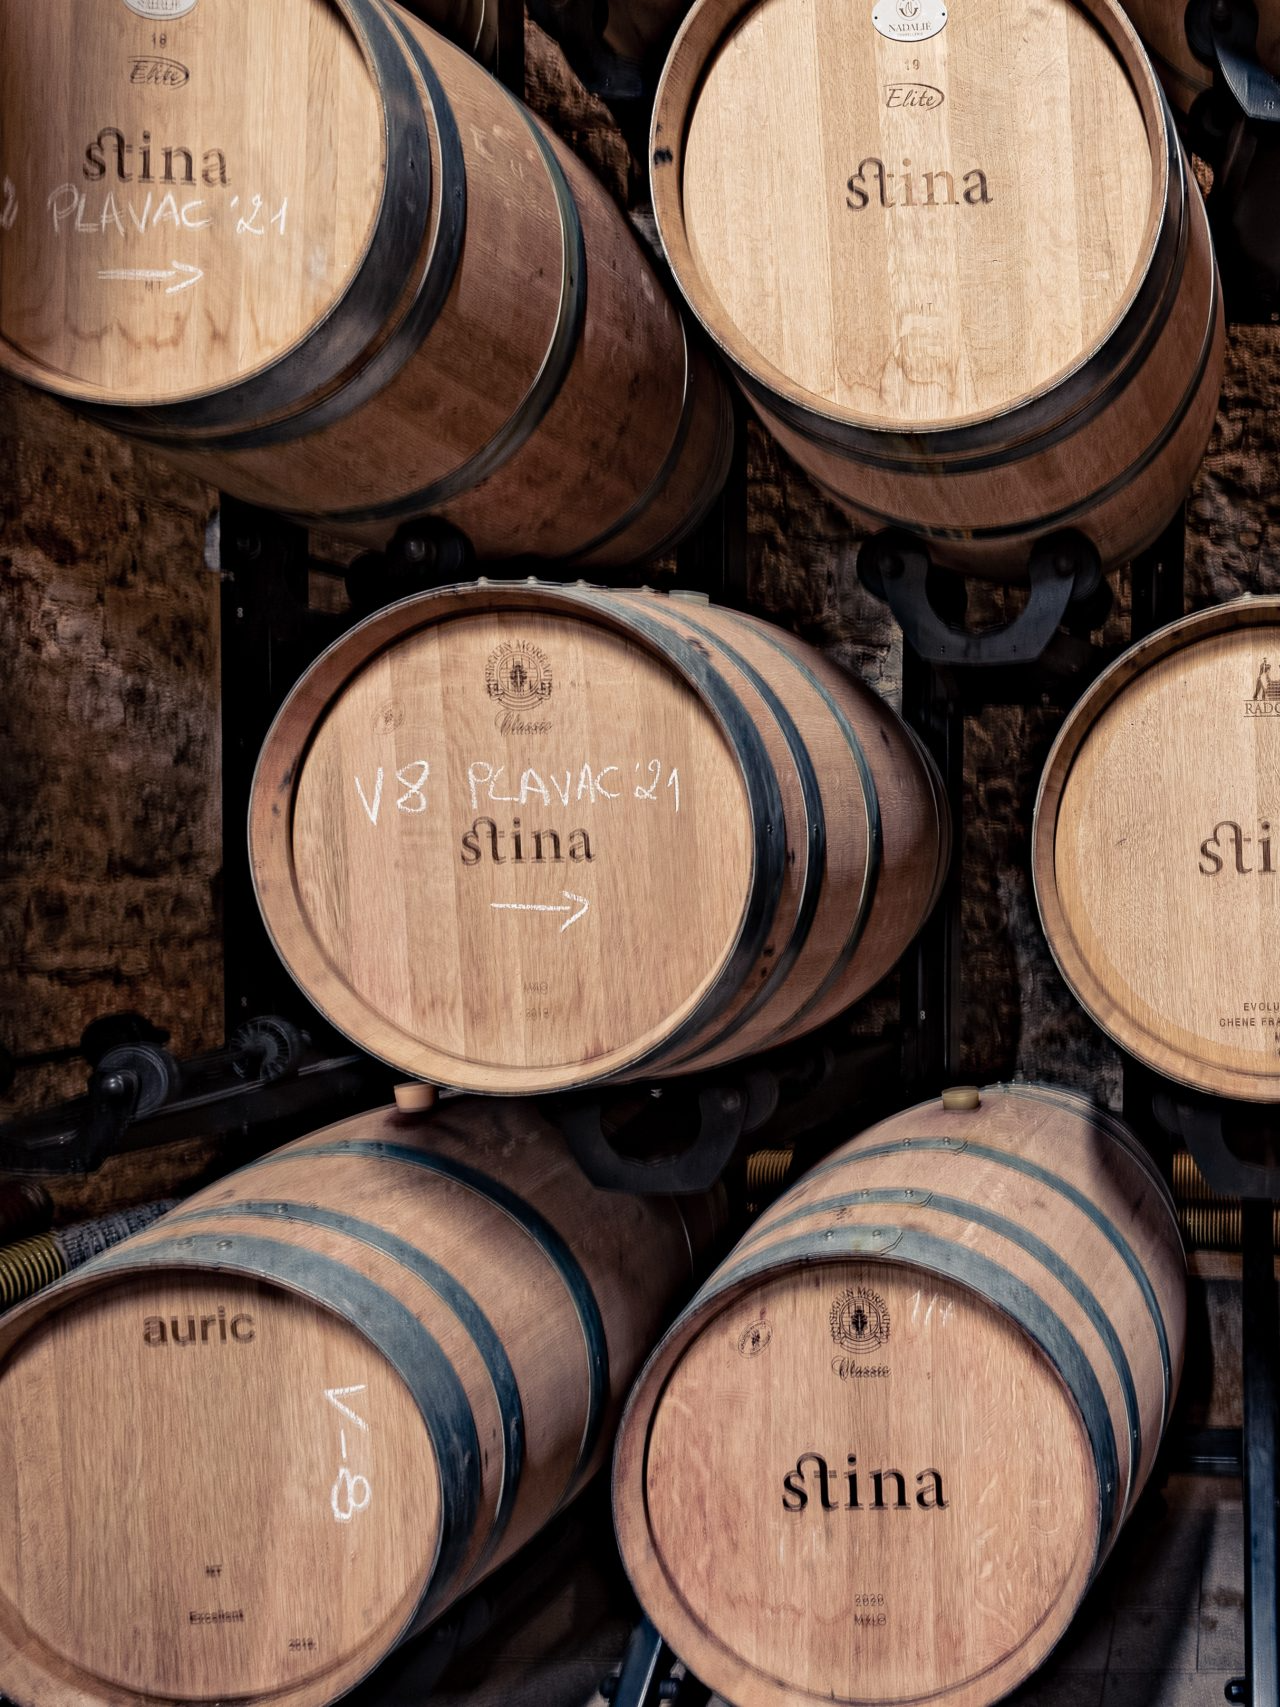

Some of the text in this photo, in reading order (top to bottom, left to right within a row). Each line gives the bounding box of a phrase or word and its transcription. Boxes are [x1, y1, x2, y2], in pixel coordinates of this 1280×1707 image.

[130, 61, 179, 86] Elite
[886, 87, 937, 109] Elite
[82, 126, 232, 187] stina
[846, 157, 993, 210] stina
[48, 183, 211, 236] PLAVAC
[460, 815, 596, 866] stina
[1219, 1018, 1256, 1028] CHENE
[143, 1305, 255, 1347] auric
[831, 1355, 891, 1382] Classic
[782, 1452, 949, 1512] stina
